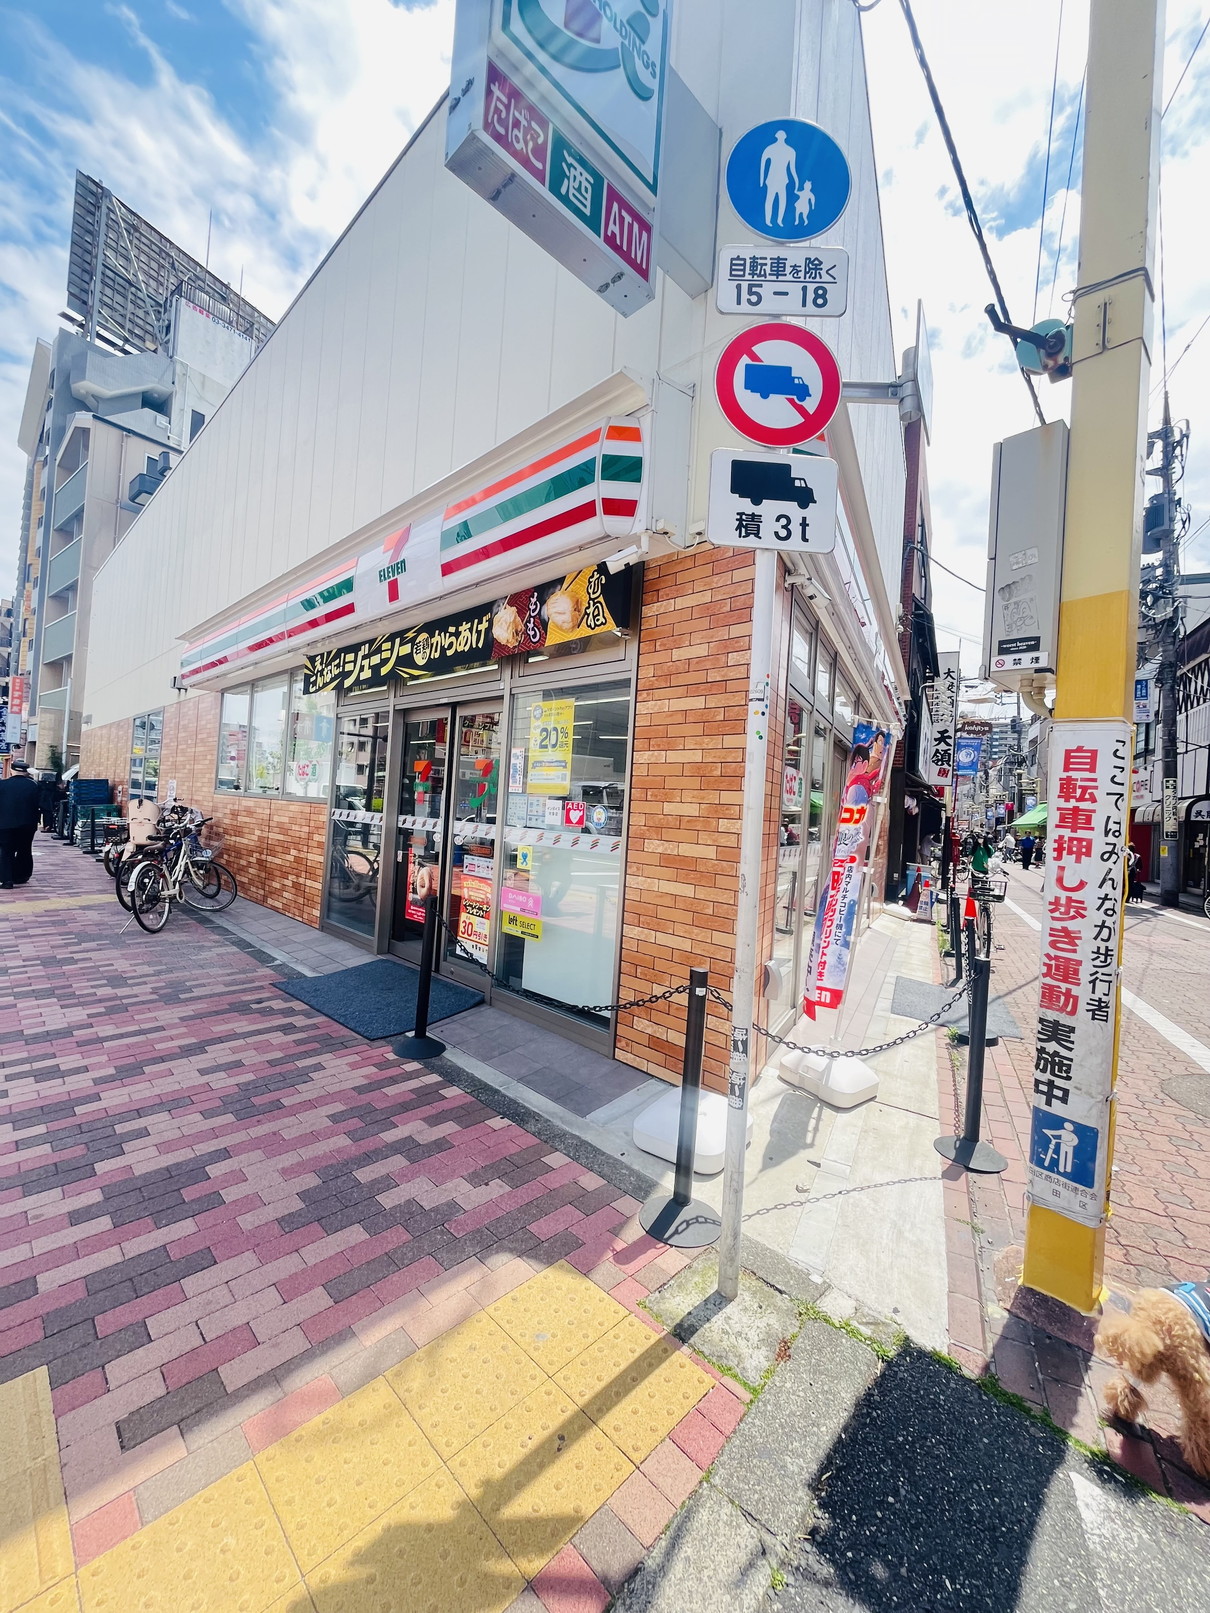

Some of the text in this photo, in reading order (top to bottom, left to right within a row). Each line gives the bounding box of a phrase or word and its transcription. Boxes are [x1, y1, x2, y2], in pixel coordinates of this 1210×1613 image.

[487, 81, 545, 171] たばこ
[560, 147, 595, 217] 酒
[606, 202, 648, 271] ATM
[729, 255, 837, 281] 自転車を除く
[734, 512, 763, 540] 積
[527, 591, 541, 643] もも
[585, 571, 606, 629] むね
[430, 612, 492, 660] からあげ
[343, 637, 412, 689] ジューシー
[930, 728, 953, 767] 天領
[567, 802, 584, 810] AED
[833, 865, 853, 946] 店内マルチコピー機にて
[1086, 739, 1126, 1024] ここではみんなが歩行者
[519, 919, 537, 931] SELECT
